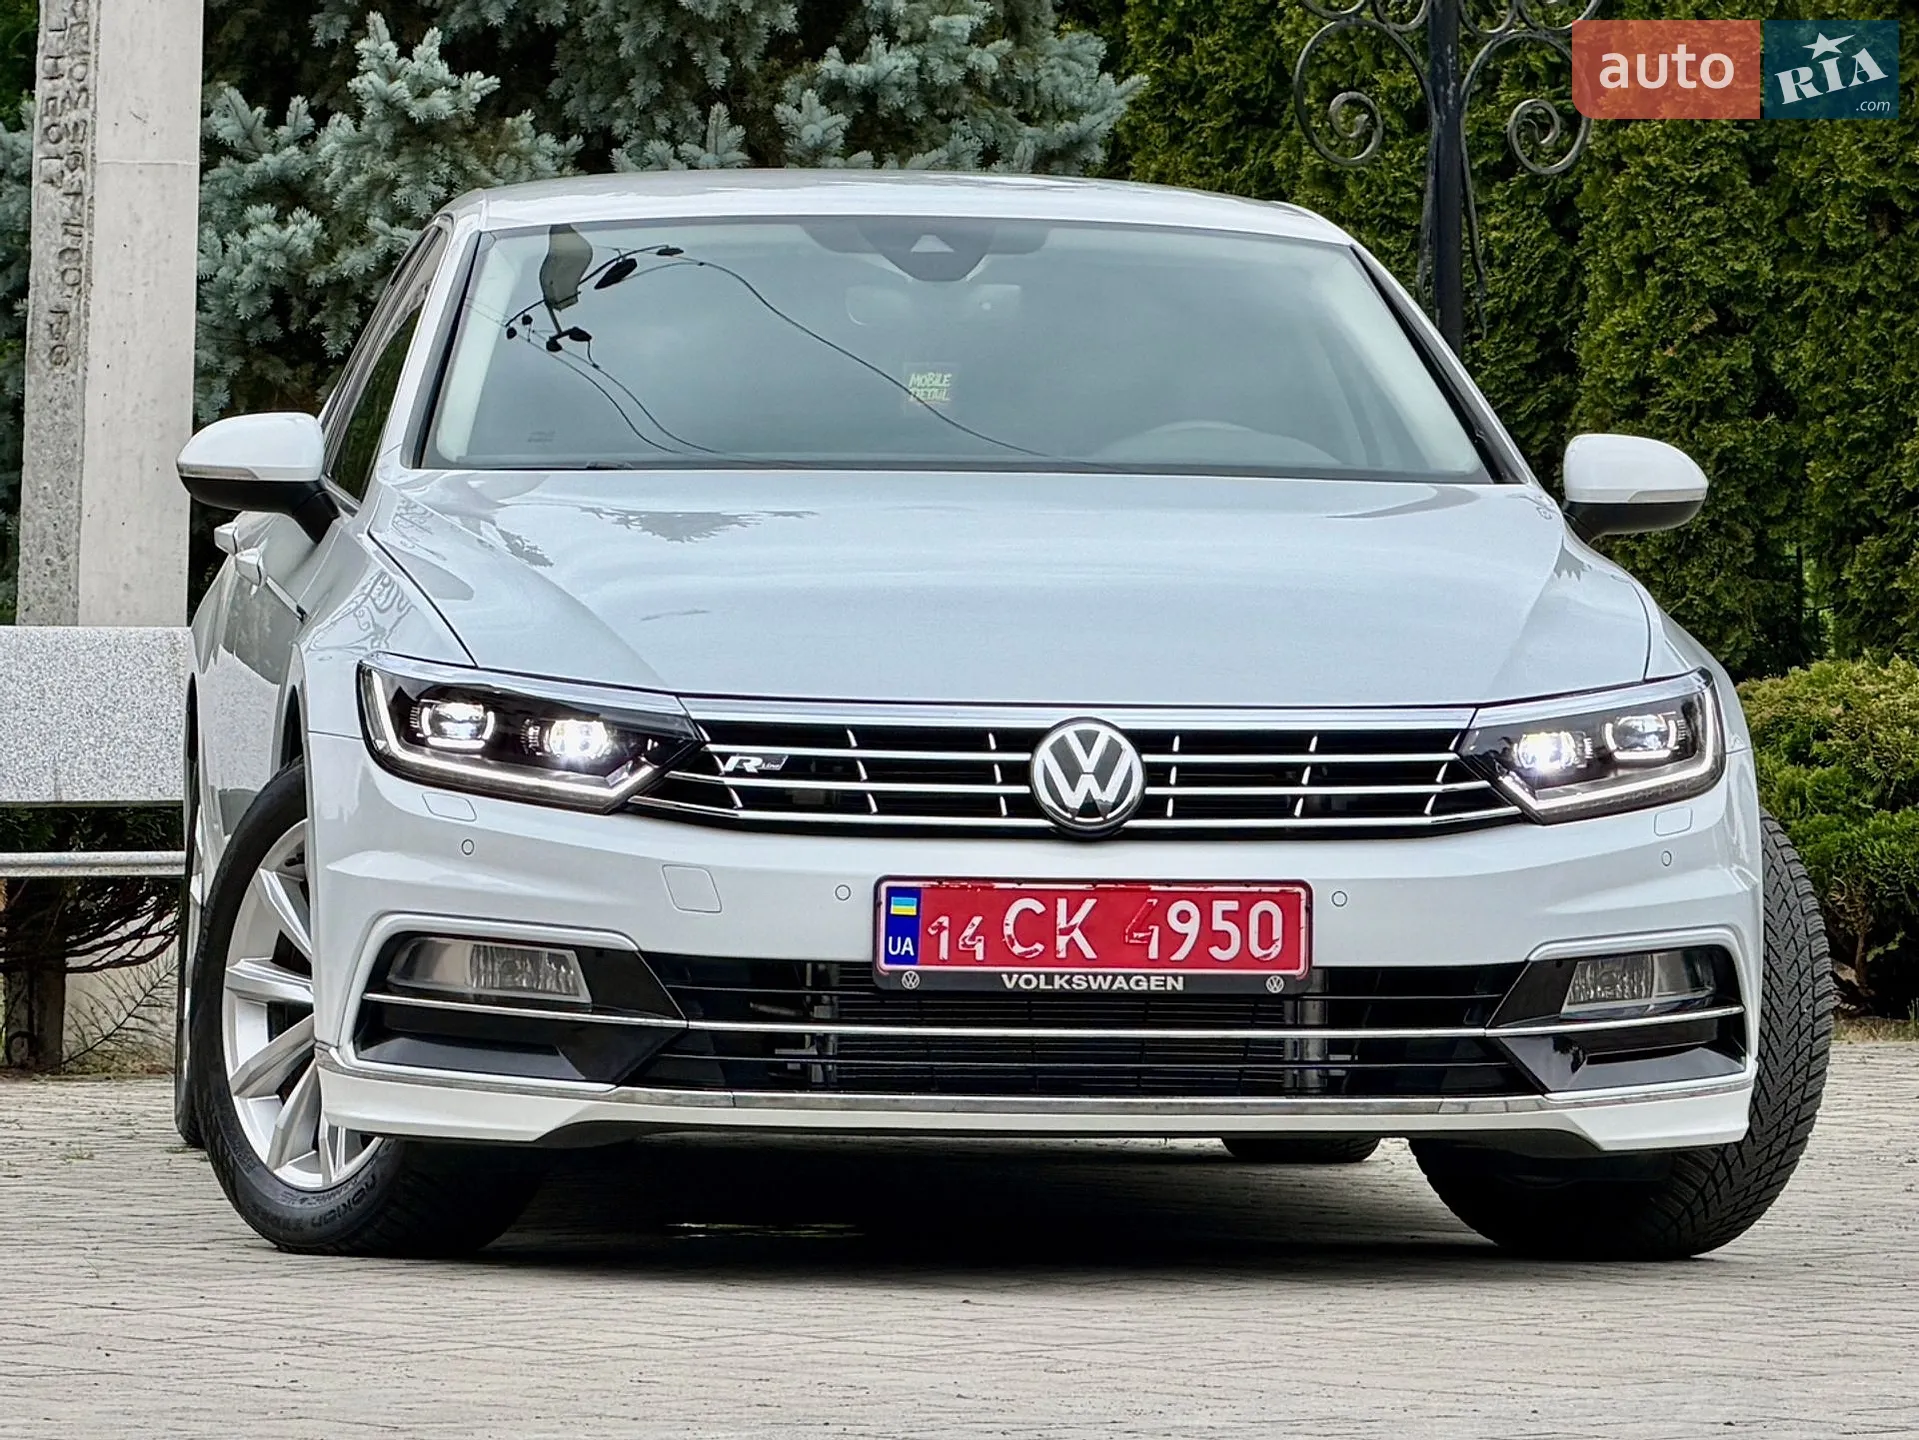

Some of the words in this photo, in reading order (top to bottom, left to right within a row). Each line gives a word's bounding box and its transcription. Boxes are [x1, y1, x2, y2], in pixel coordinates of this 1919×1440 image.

[908, 372, 952, 387] MOBILE
[927, 915, 985, 961] 14
[1002, 897, 1098, 960] CK
[1124, 899, 1284, 962] 4950
[888, 935, 915, 957] UA
[1001, 973, 1184, 991] VOLKSWAGEN
